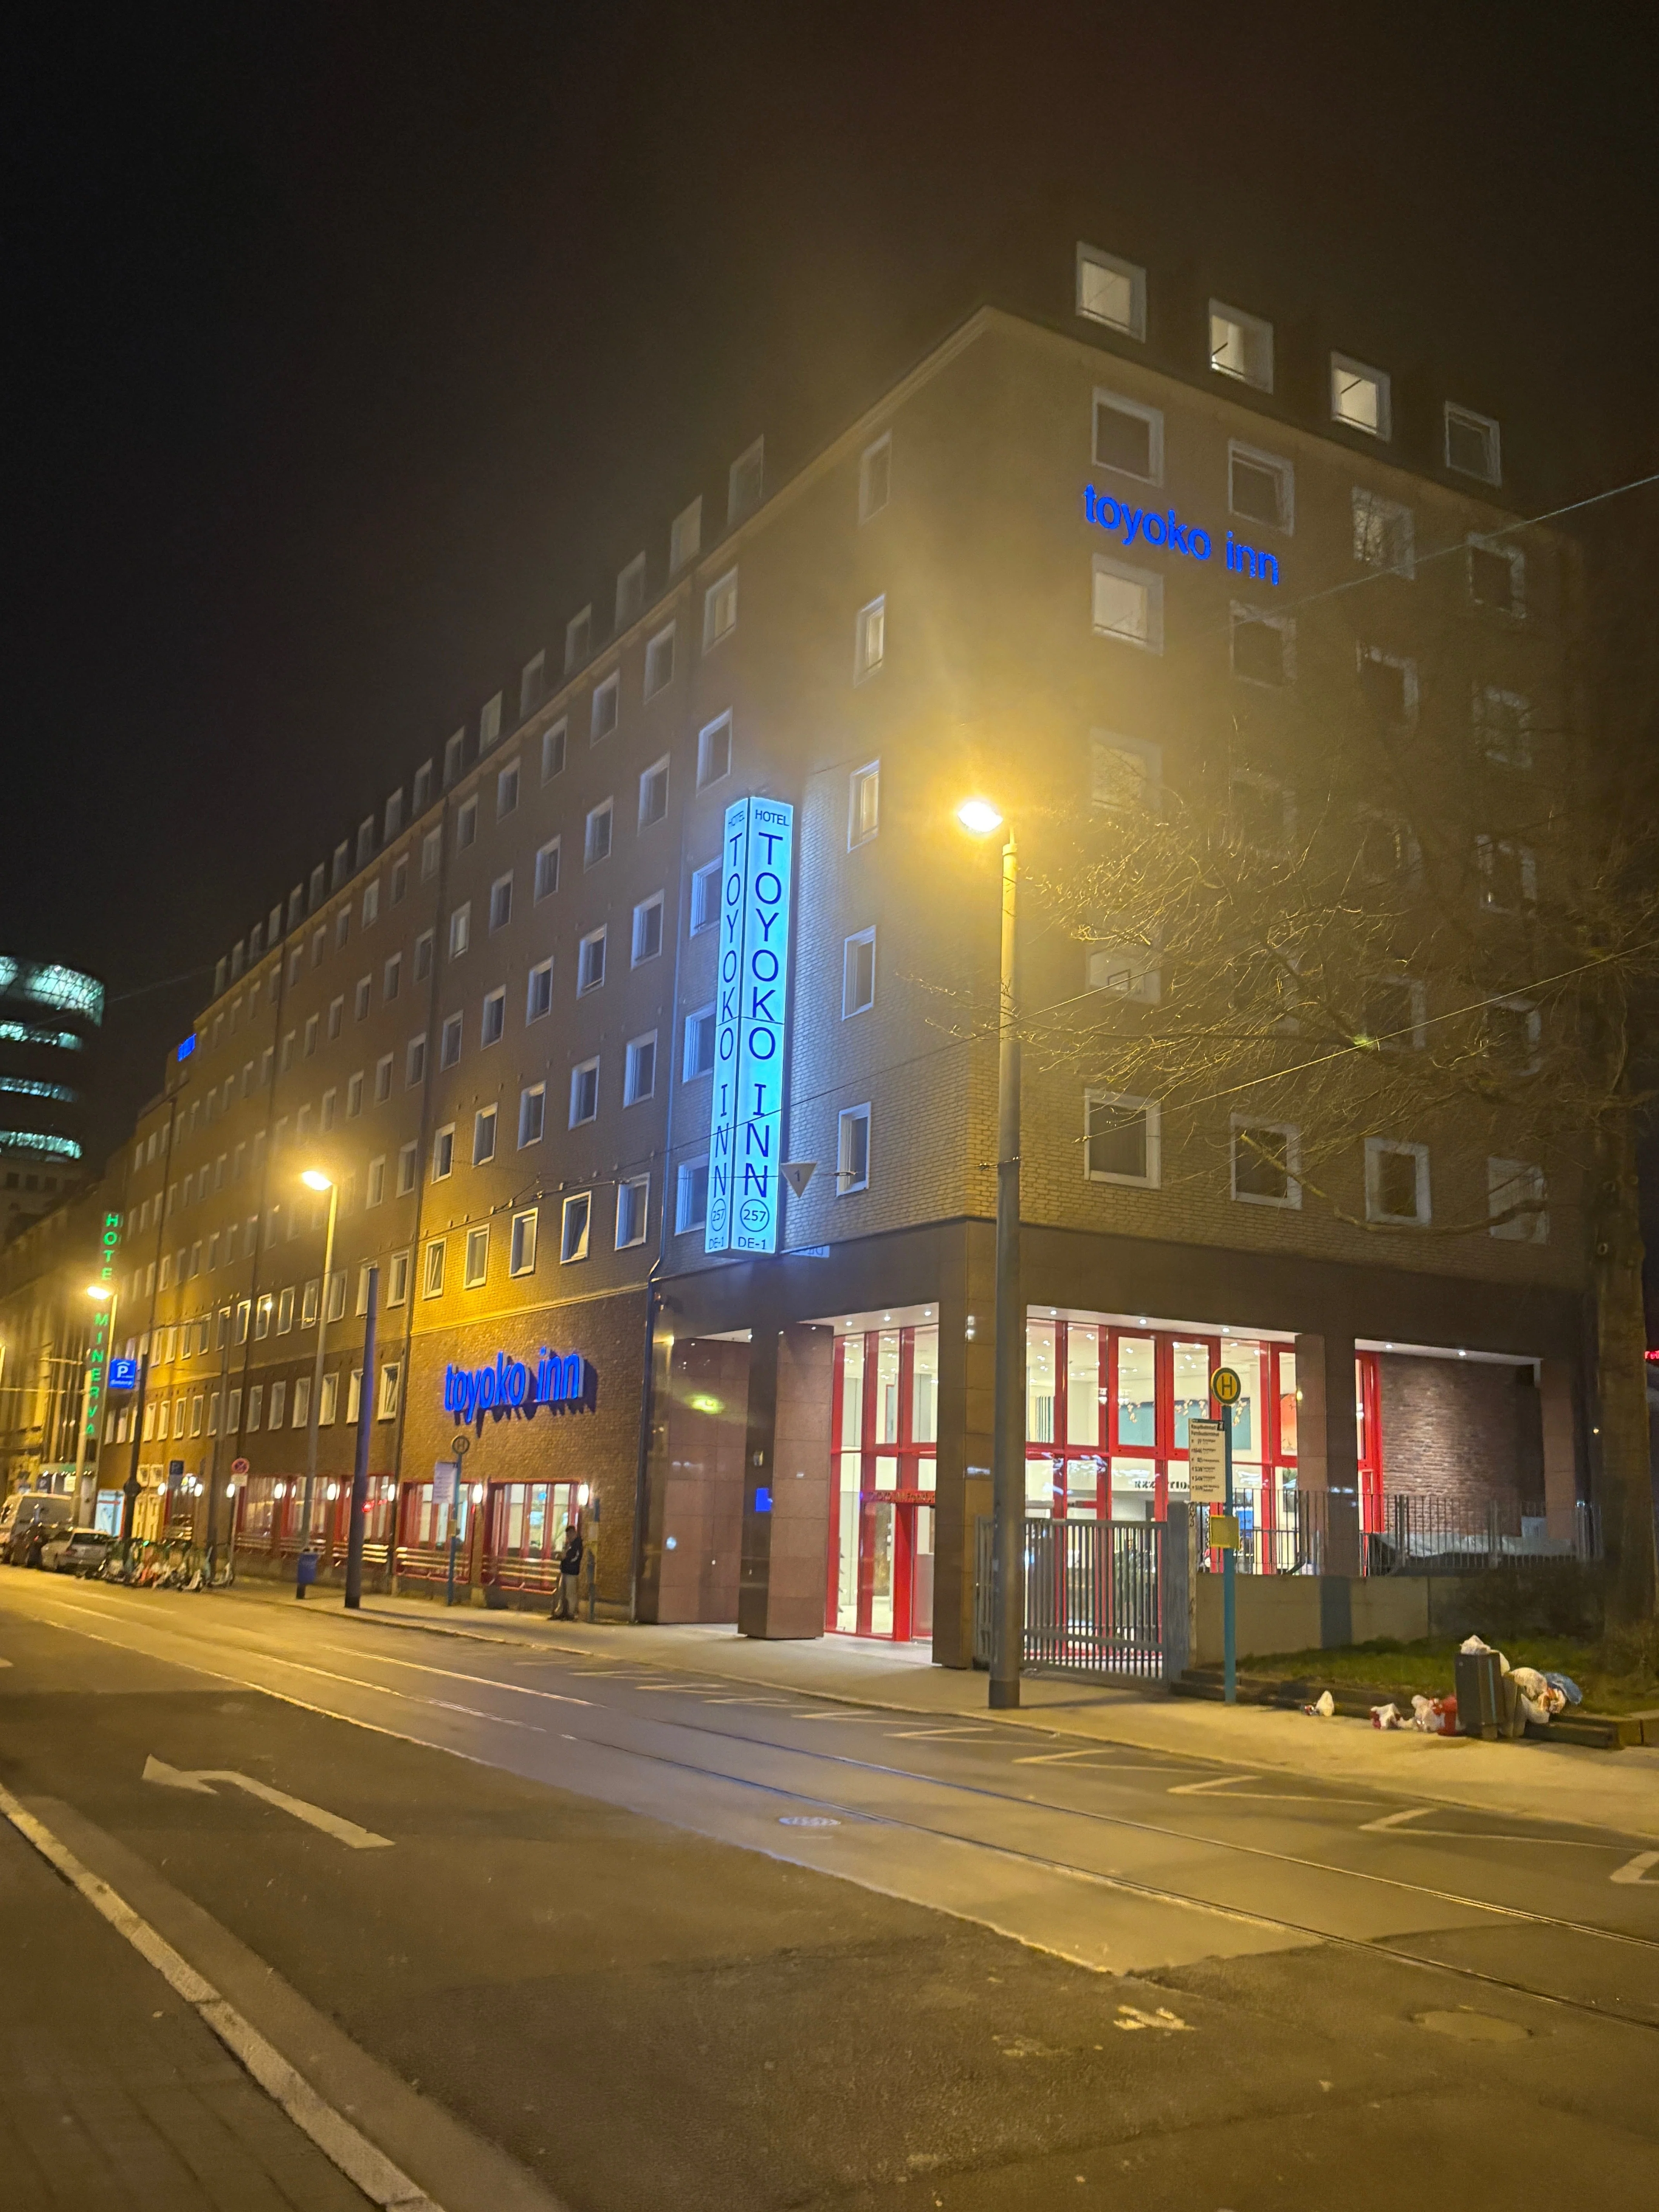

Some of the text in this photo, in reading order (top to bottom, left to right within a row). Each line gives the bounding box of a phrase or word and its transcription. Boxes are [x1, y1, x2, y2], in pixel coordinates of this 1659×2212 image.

[1084, 483, 1279, 586] toyoko inn
[755, 809, 789, 826] HOTEL
[714, 833, 742, 1198] TOYOKO INN
[744, 832, 783, 1198] TOYOKO INN
[794, 1170, 800, 1182] 1
[712, 1208, 725, 1221] 257
[744, 1209, 766, 1222] 257
[101, 1213, 119, 1280] HOTE
[738, 1237, 766, 1250] DE-1
[86, 1313, 109, 1435] MINERVA
[445, 1346, 580, 1424] toyoko inn
[1221, 1376, 1233, 1396] H
